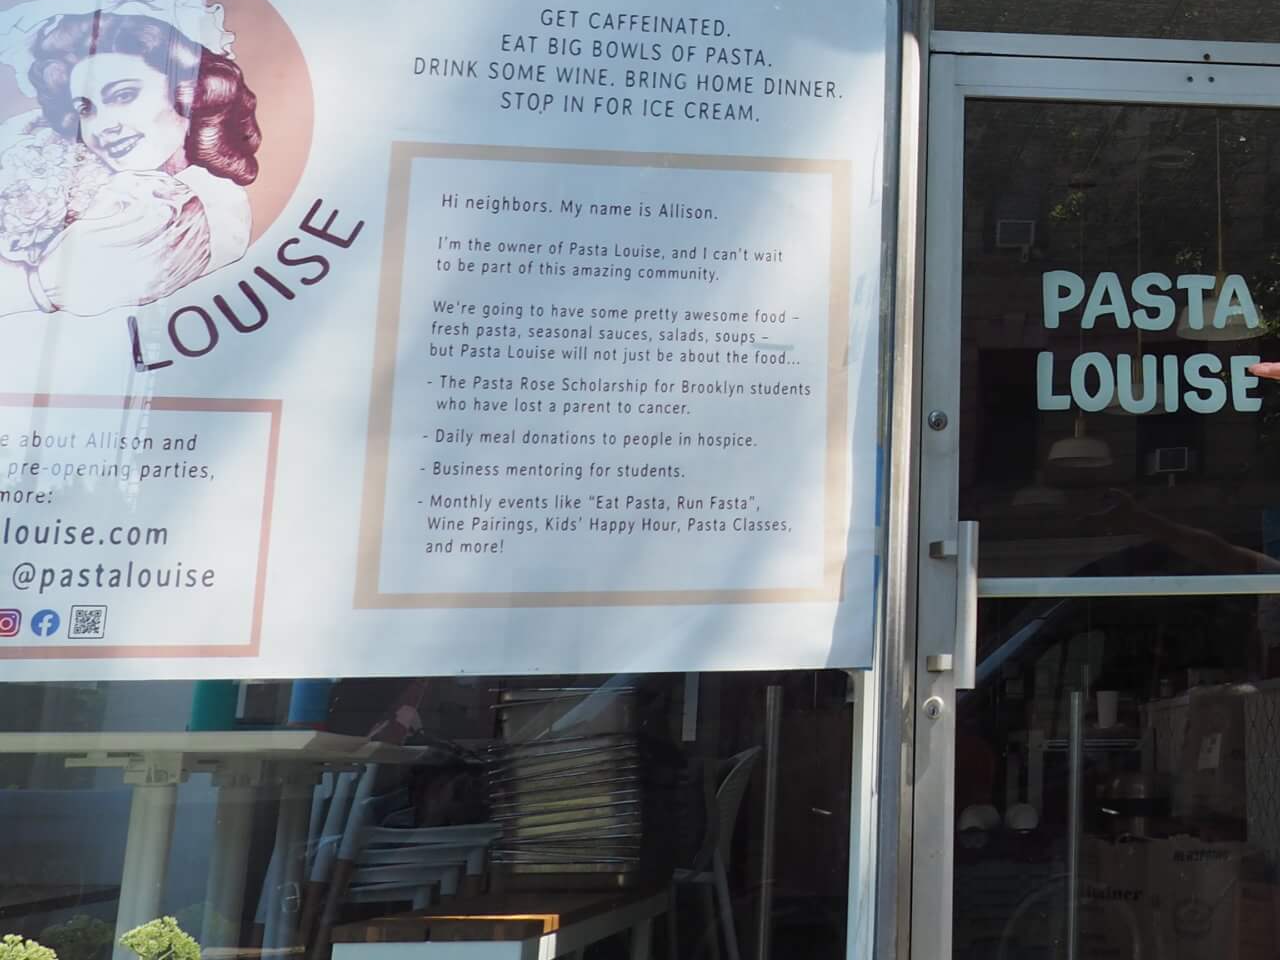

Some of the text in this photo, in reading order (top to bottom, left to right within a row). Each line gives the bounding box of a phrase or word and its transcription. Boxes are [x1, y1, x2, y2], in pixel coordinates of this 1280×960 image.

[540, 9, 732, 38] GET CAFFEINATED.
[501, 34, 773, 68] EAT BIG BOWLS OF PASTA.
[413, 57, 844, 100] DRINK SOME WINE. BRING HOME DINNER.
[500, 92, 761, 122] STOP IN FOR ICE CREAM.
[441, 193, 718, 220] Hi neighbors. My name is Allison.
[437, 237, 783, 262] I'm the owner of Pasta Louise, and I can't wait
[436, 259, 720, 283] to be part of this amazing community.
[127, 198, 365, 372] LOUISE
[432, 300, 476, 315] We're
[482, 302, 523, 319] going
[529, 303, 544, 317] to
[551, 304, 585, 319] have
[590, 307, 628, 319] some
[634, 307, 678, 323] pretty
[684, 309, 749, 322] awesome
[754, 308, 786, 323] food
[1042, 270, 1260, 330] PASTA
[431, 321, 470, 336] fresh
[476, 323, 522, 341] pasta,
[527, 325, 593, 339] seasonal
[599, 327, 652, 343] sauces,
[658, 328, 709, 343] salads,
[714, 330, 756, 346] soups
[430, 343, 454, 358] but
[460, 343, 501, 358] Pasta
[507, 345, 555, 360] Louise
[562, 345, 588, 360] will
[593, 347, 617, 361] not
[621, 347, 650, 365] just
[656, 348, 674, 363] be
[679, 349, 720, 363] about
[726, 350, 749, 364] the
[440, 375, 466, 390] The
[472, 376, 513, 391] Pasta
[520, 377, 555, 392] Rose
[562, 377, 648, 396] Scholarship
[654, 379, 675, 393] for
[681, 379, 744, 396] Brooklyn
[749, 381, 811, 396] students
[1036, 351, 1263, 414] LOUISE
[436, 398, 691, 416] who have lost a parent to cancer.
[19, 431, 77, 448] about
[86, 432, 153, 450] Allison
[162, 434, 198, 451] and
[435, 428, 474, 446] Daily
[479, 429, 516, 445] meal
[522, 430, 596, 445] donations
[601, 431, 617, 446] to
[623, 432, 673, 449] people
[678, 432, 692, 446] in
[698, 432, 758, 449] hospice.
[140, 461, 215, 481] parties,
[432, 461, 500, 476] Business
[505, 462, 583, 480] mentoring
[589, 462, 611, 478] for
[617, 464, 685, 478] students.
[430, 494, 492, 512] Monthly
[498, 495, 549, 509] events
[554, 495, 582, 509] like
[626, 496, 671, 511] Pasta,
[676, 497, 703, 510] Run
[3, 517, 168, 545] louise.com
[427, 517, 793, 535] Wine Pairings, Kids' Happy Hour, Pasta Classes,
[425, 540, 505, 554] and more!
[12, 561, 215, 593] @pastalouise
